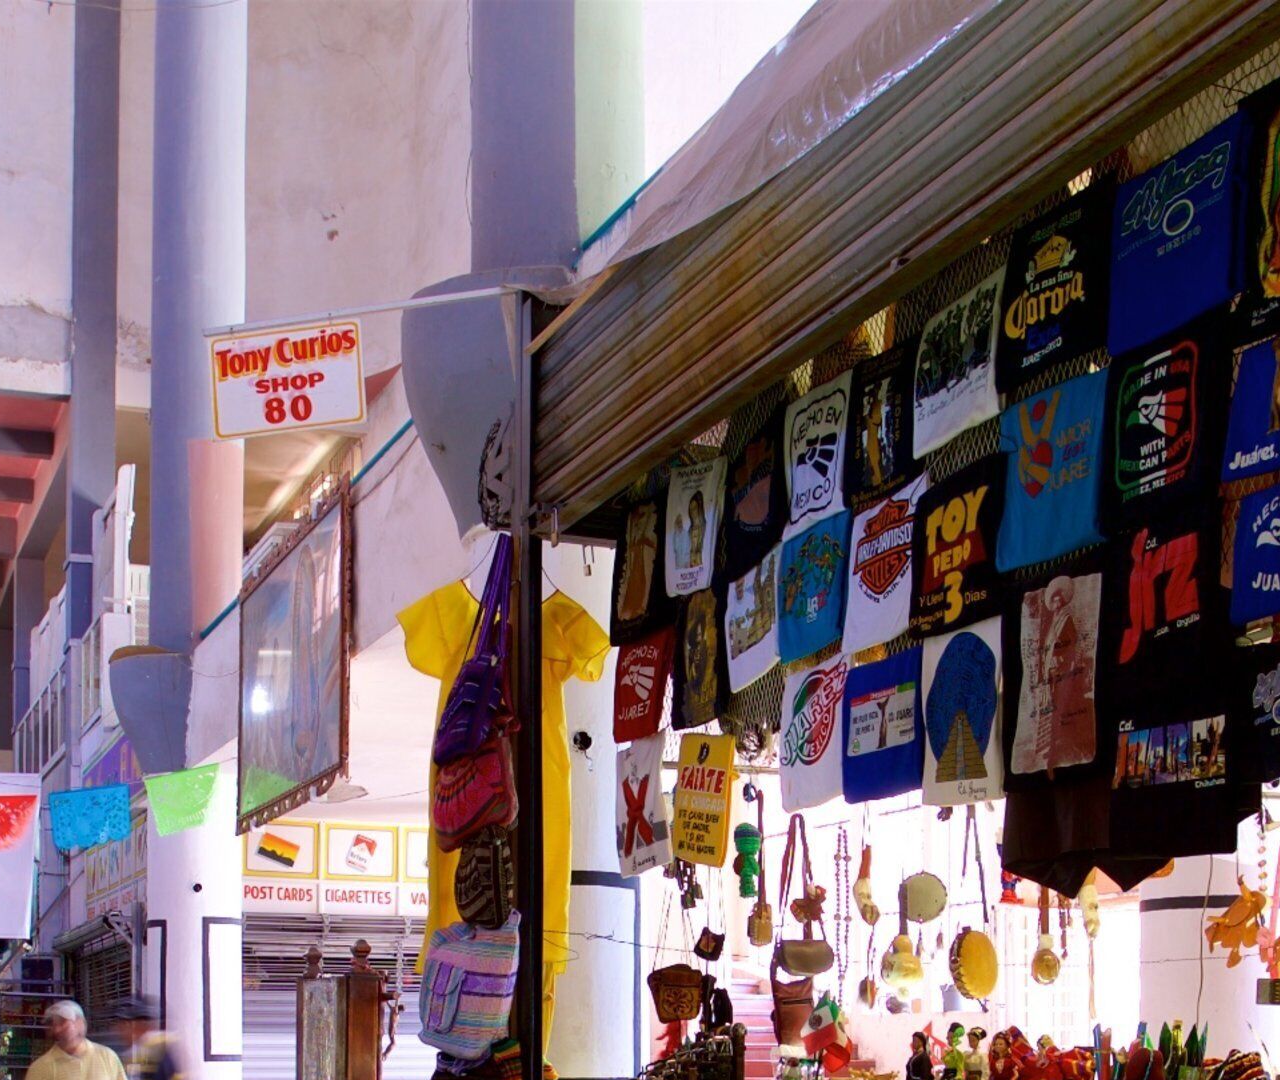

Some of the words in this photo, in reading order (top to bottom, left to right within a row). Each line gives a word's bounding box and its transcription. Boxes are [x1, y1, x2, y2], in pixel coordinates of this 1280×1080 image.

[1004, 271, 1086, 341] Corona
[215, 346, 272, 378] Tony
[276, 329, 356, 363] Curios
[255, 371, 325, 394] SHOP
[1153, 363, 1168, 381] IN
[264, 394, 313, 424] 80
[824, 405, 843, 426] EN
[1139, 436, 1166, 458] WITH
[1119, 453, 1160, 473] MEXICAN
[925, 484, 990, 556] TOY
[932, 538, 972, 579] PEDO
[943, 570, 964, 625] 3
[1119, 527, 1200, 665] jrz
[622, 645, 649, 671] HECHO
[780, 662, 848, 768] JUAREZ
[243, 884, 275, 900] POST
[276, 886, 313, 903] CARDS
[325, 888, 392, 906] CIGARETTES
